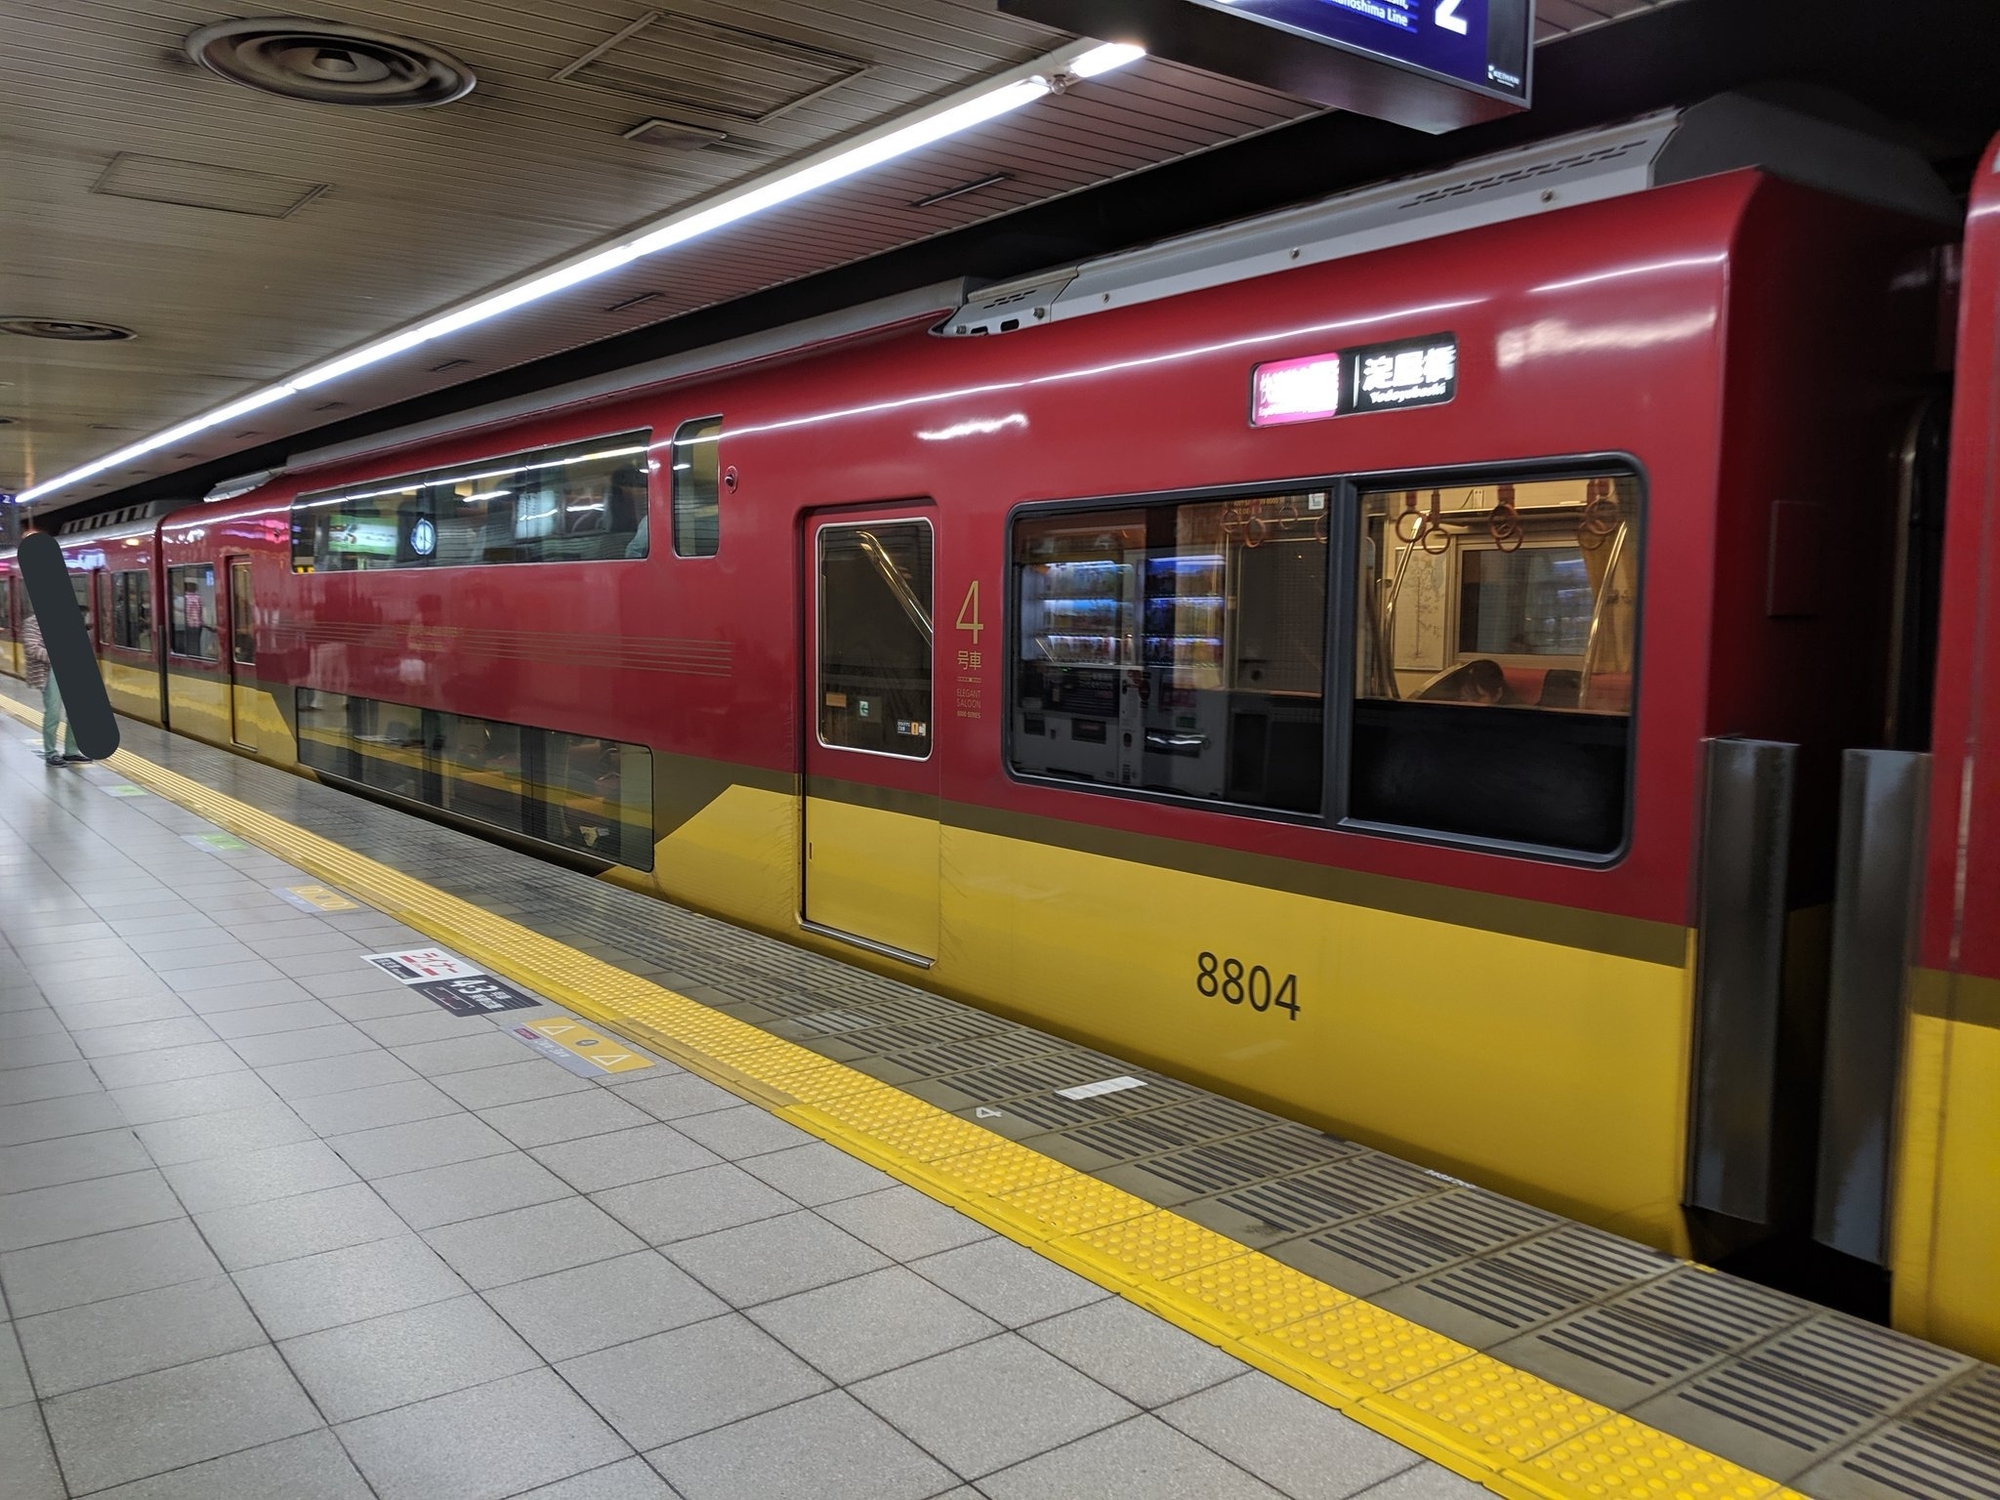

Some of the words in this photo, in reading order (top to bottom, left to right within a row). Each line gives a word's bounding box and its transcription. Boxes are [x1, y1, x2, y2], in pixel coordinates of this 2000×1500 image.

[1386, 7, 1409, 27] Line
[2, 494, 12, 504] 2
[955, 580, 984, 645] 4
[957, 650, 982, 671] 号車
[956, 698, 982, 709] SALOON
[1197, 951, 1301, 1021] 8804
[976, 1106, 1003, 1118] 4
